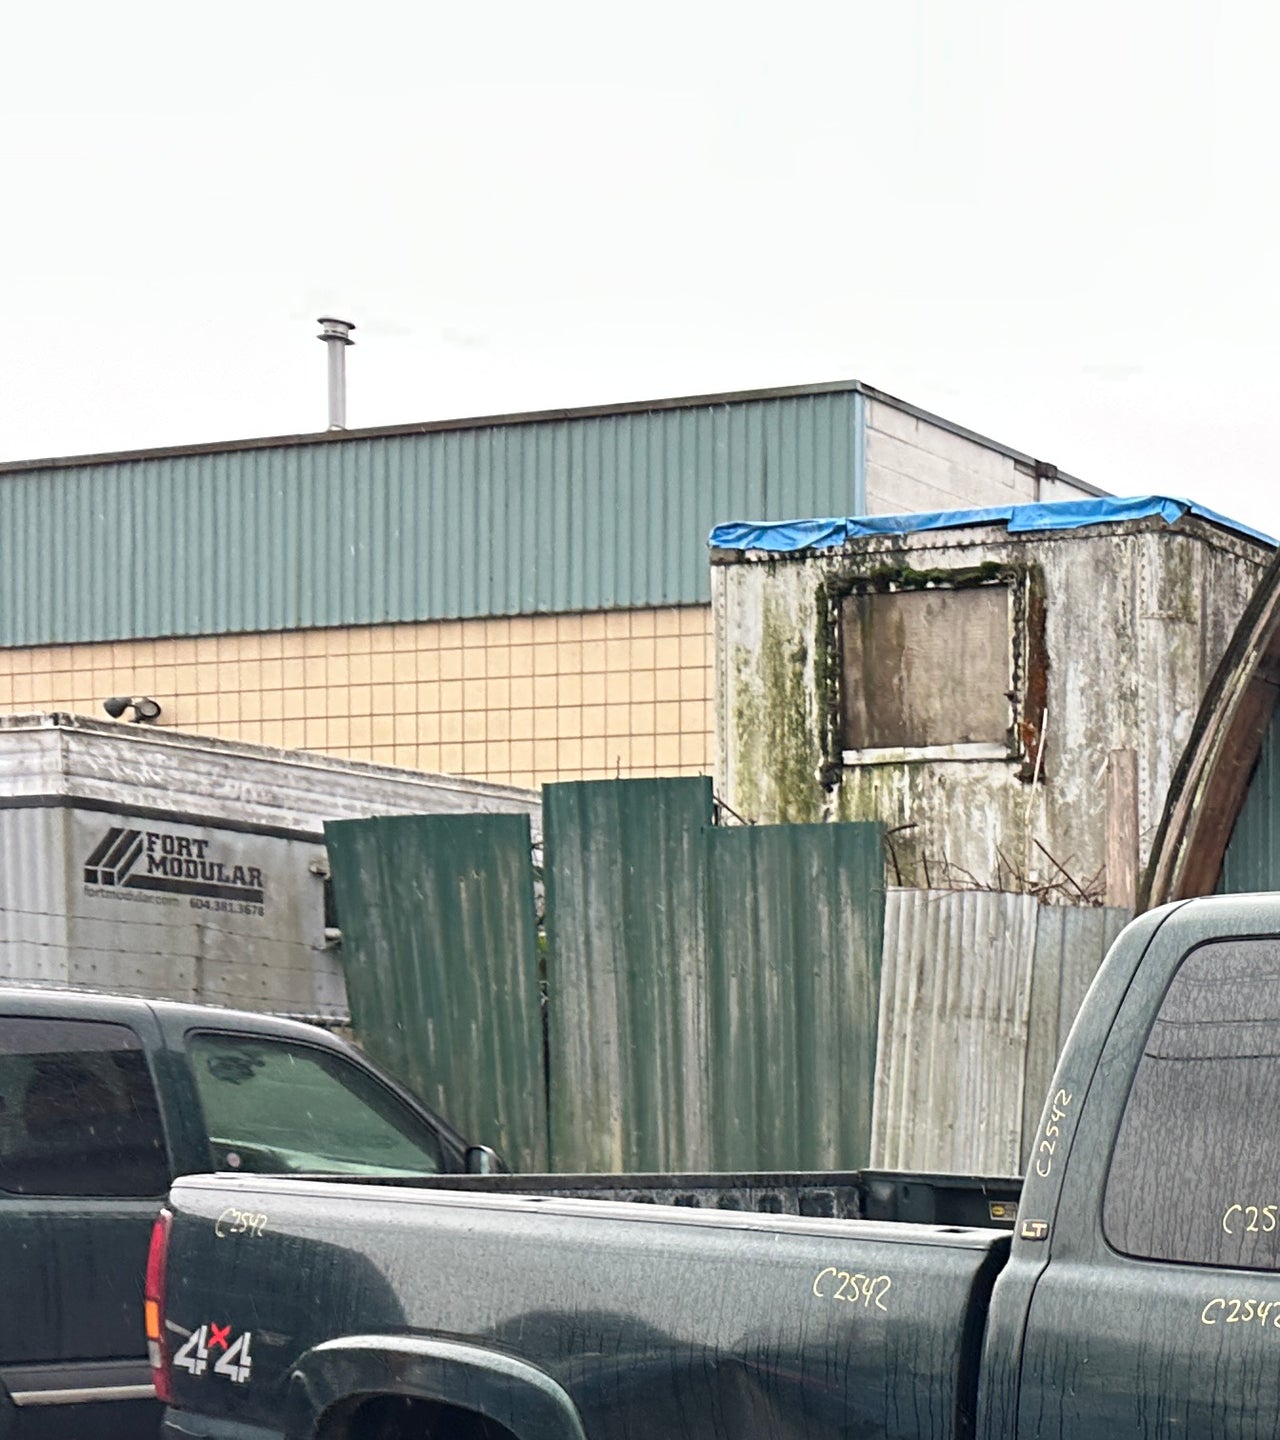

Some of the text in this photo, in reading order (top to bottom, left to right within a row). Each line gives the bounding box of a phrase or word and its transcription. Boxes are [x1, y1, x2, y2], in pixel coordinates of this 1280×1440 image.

[146, 832, 208, 859] FORT
[147, 853, 263, 887] MODULAR
[1035, 1089, 1071, 1177] C2542
[215, 1207, 268, 1238] C2542
[1021, 1223, 1048, 1237] LT
[813, 1267, 892, 1312] C2542
